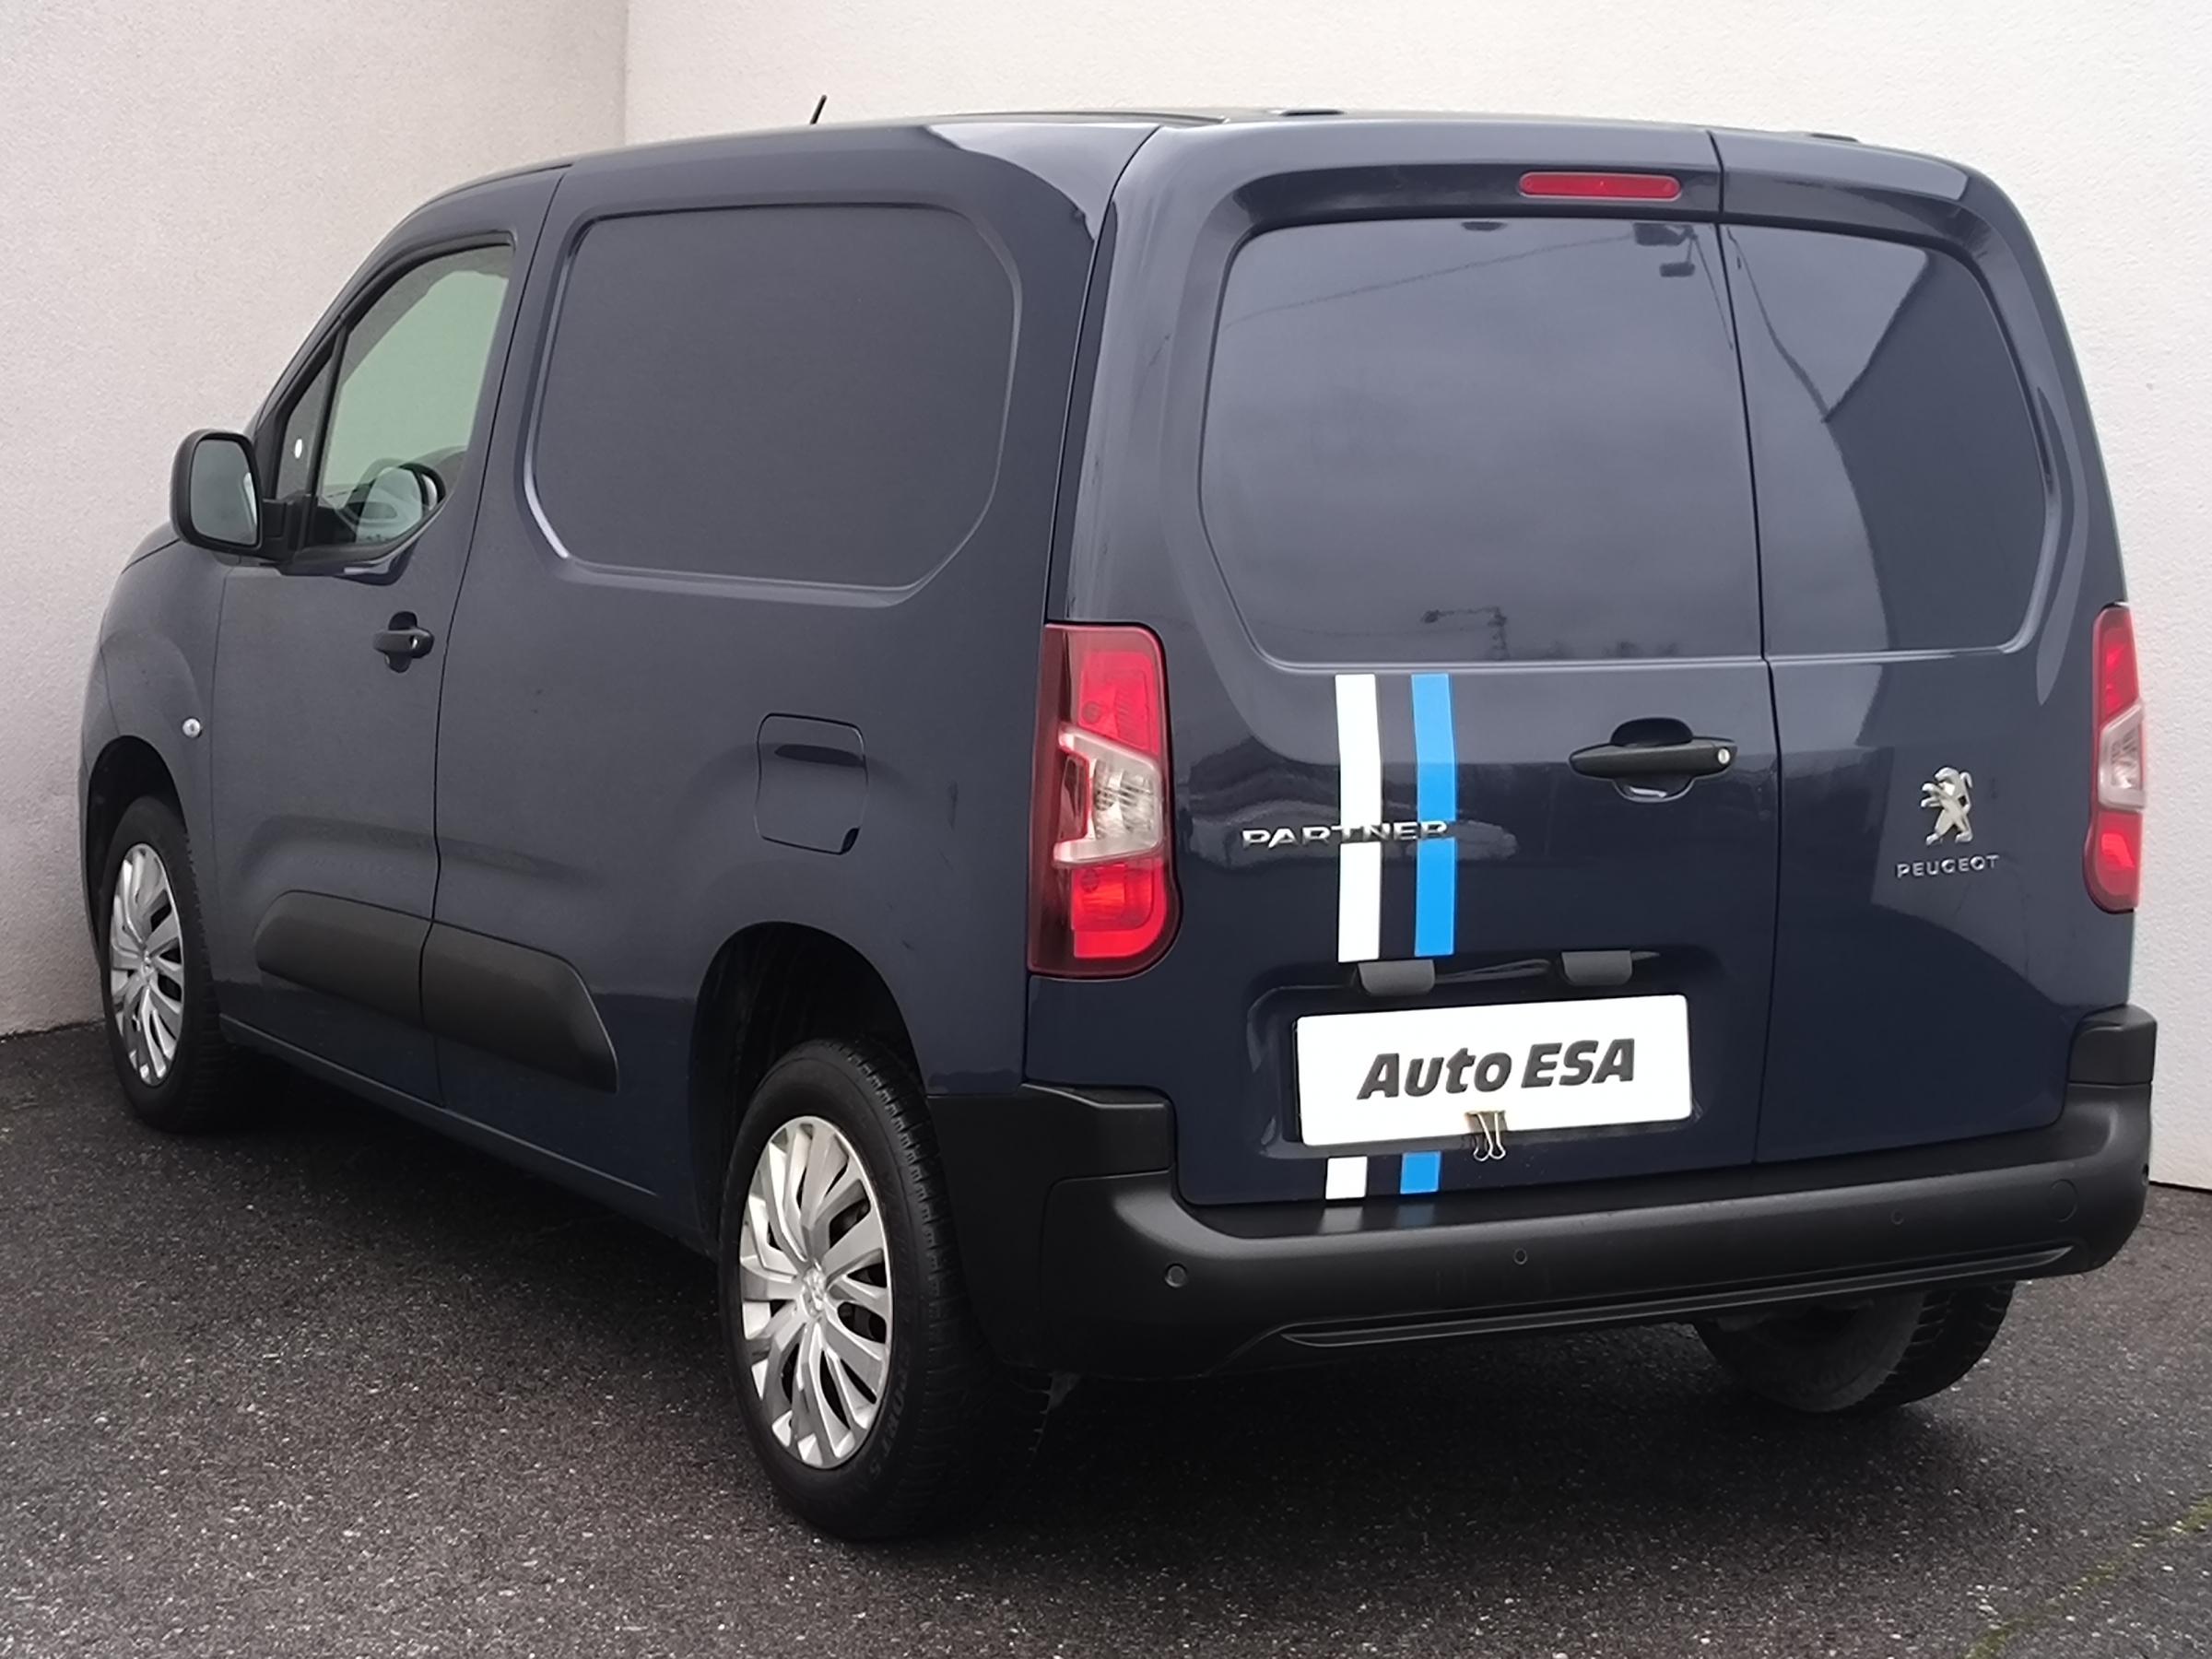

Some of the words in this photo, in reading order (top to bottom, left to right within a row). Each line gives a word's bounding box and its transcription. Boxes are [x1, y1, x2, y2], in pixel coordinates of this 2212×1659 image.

[1241, 819, 1448, 849] PARTNER
[1896, 853, 2000, 878] PEUGEOT
[1356, 1047, 1512, 1100] Auto
[1521, 1038, 1635, 1088] ESA
